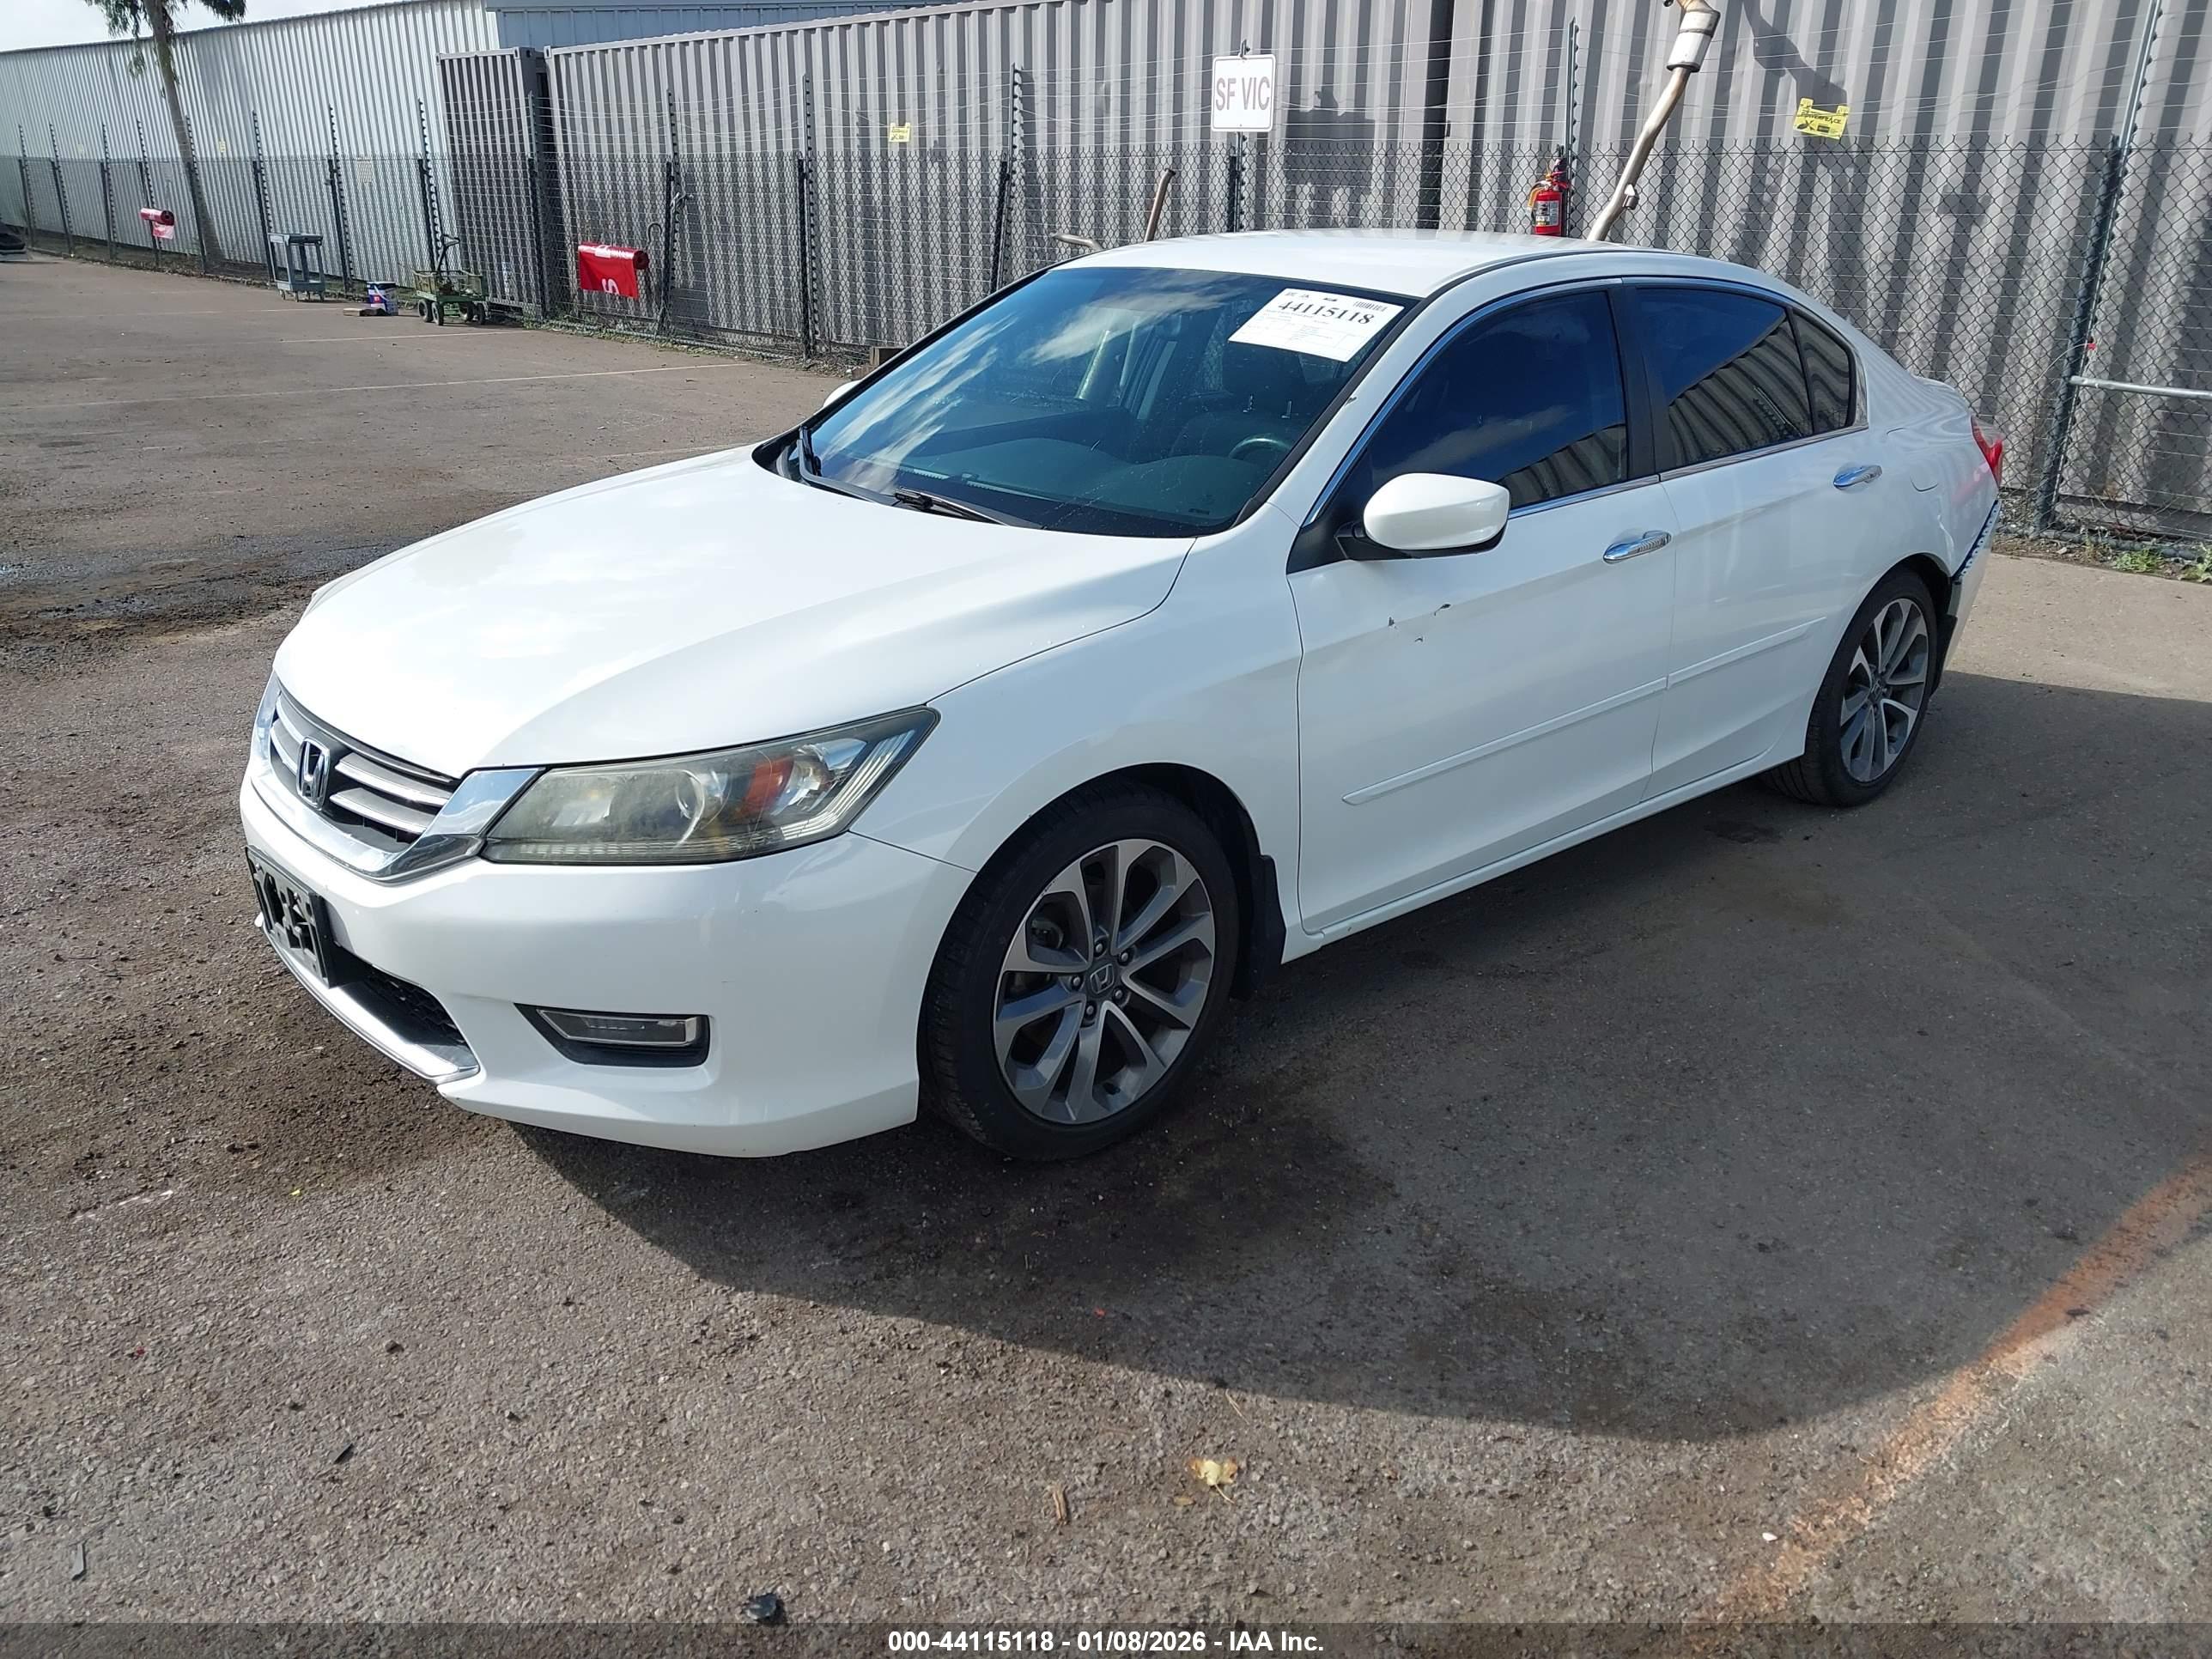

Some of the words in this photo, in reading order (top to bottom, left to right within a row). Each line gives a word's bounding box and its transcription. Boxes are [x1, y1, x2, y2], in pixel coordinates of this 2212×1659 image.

[1215, 76, 1237, 111] SF
[1242, 76, 1270, 111] VIC
[1278, 301, 1375, 325] 44115118
